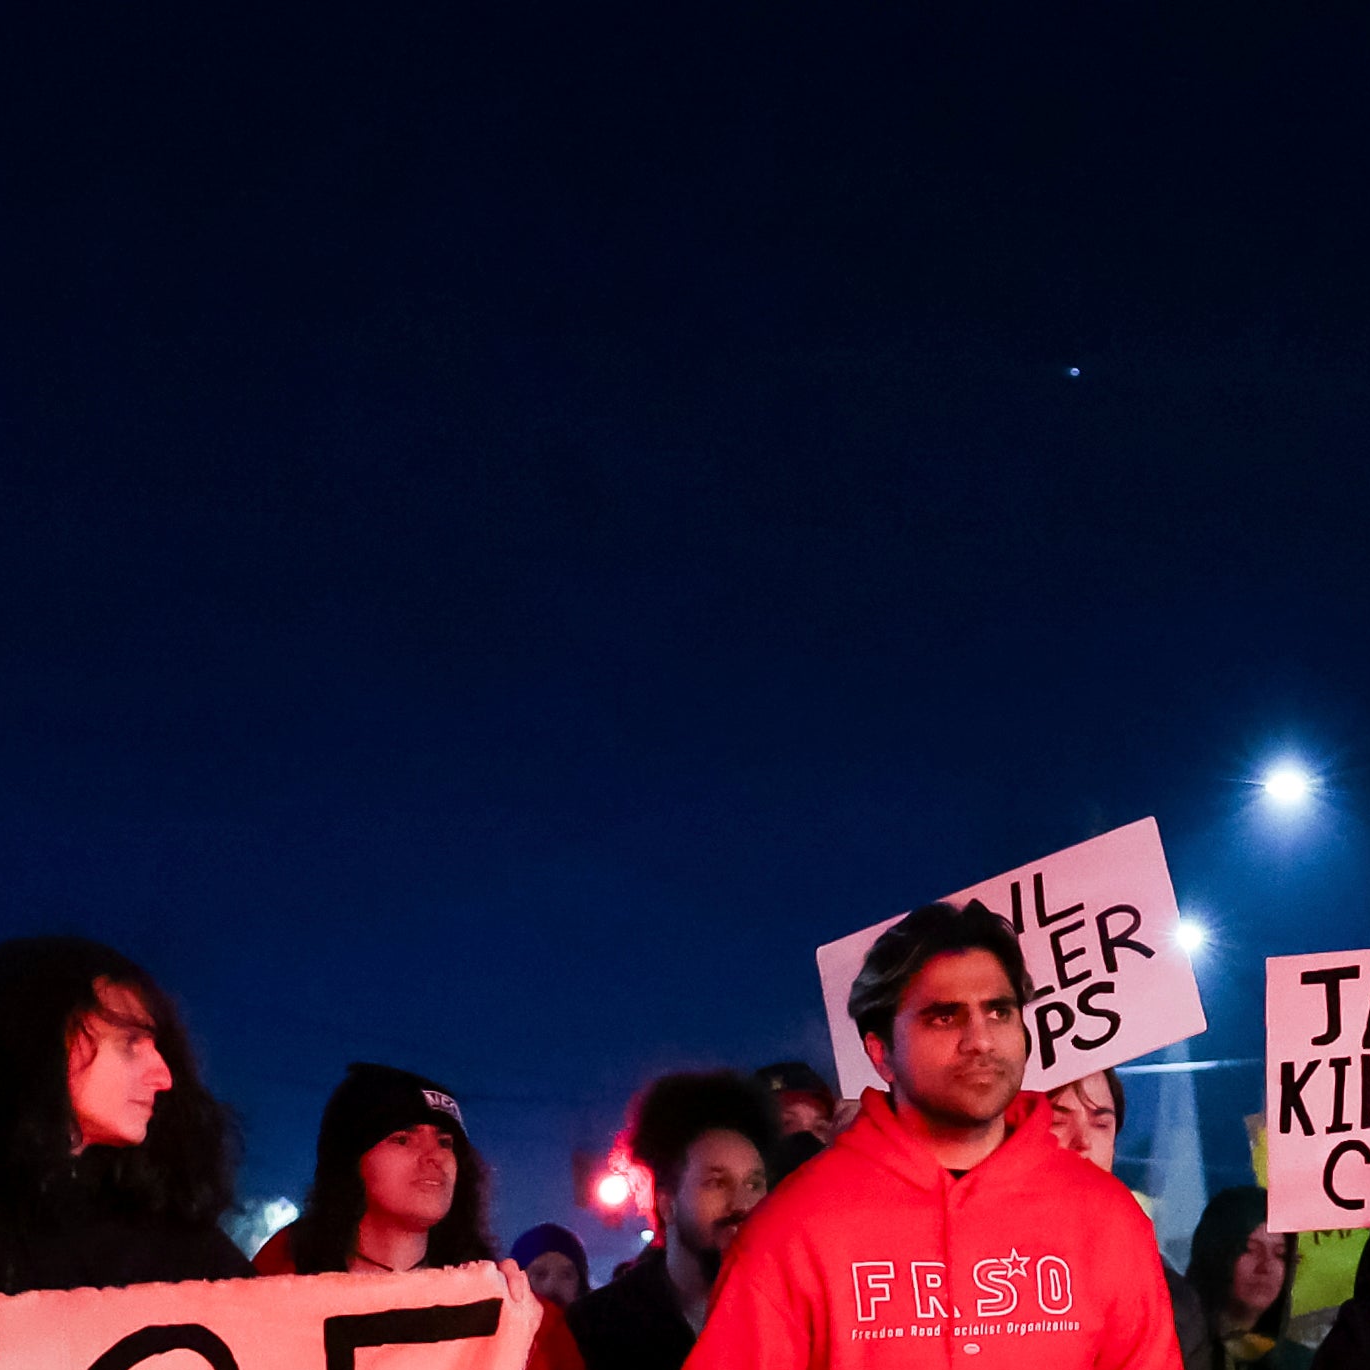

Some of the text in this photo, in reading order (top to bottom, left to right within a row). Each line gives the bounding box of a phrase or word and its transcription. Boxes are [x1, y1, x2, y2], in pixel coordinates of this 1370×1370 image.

[1010, 872, 1085, 936] IL
[1034, 981, 1121, 1071] PS
[852, 1254, 1073, 1322] FRSO
[910, 1324, 941, 1337] Road
[953, 1323, 1001, 1337] ocialist
[1006, 1320, 1081, 1336] Organization
